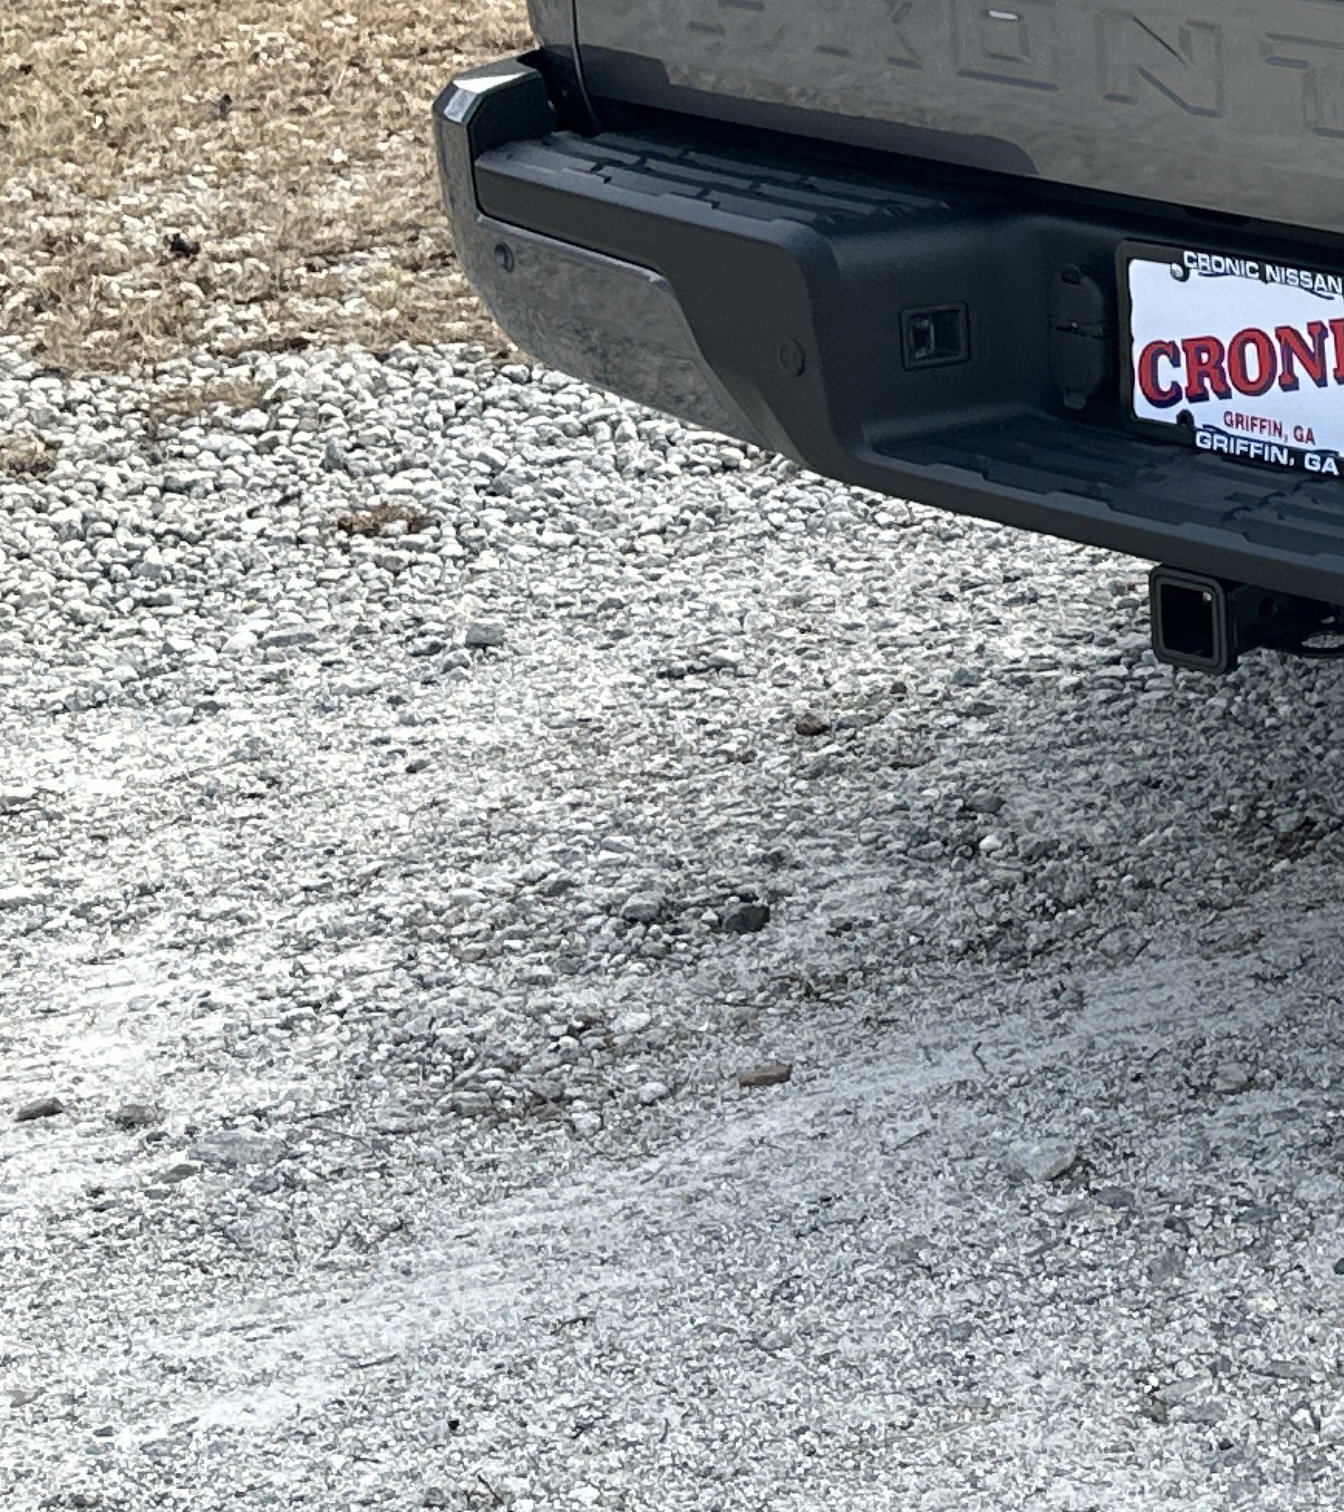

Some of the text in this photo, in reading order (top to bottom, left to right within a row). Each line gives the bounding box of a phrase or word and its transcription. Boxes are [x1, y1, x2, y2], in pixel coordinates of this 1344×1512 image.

[1183, 250, 1343, 294] CRONIC NISSAN
[1223, 410, 1317, 446] GRIFFIN, GA
[1195, 430, 1340, 477] GRIFFIN, GA
